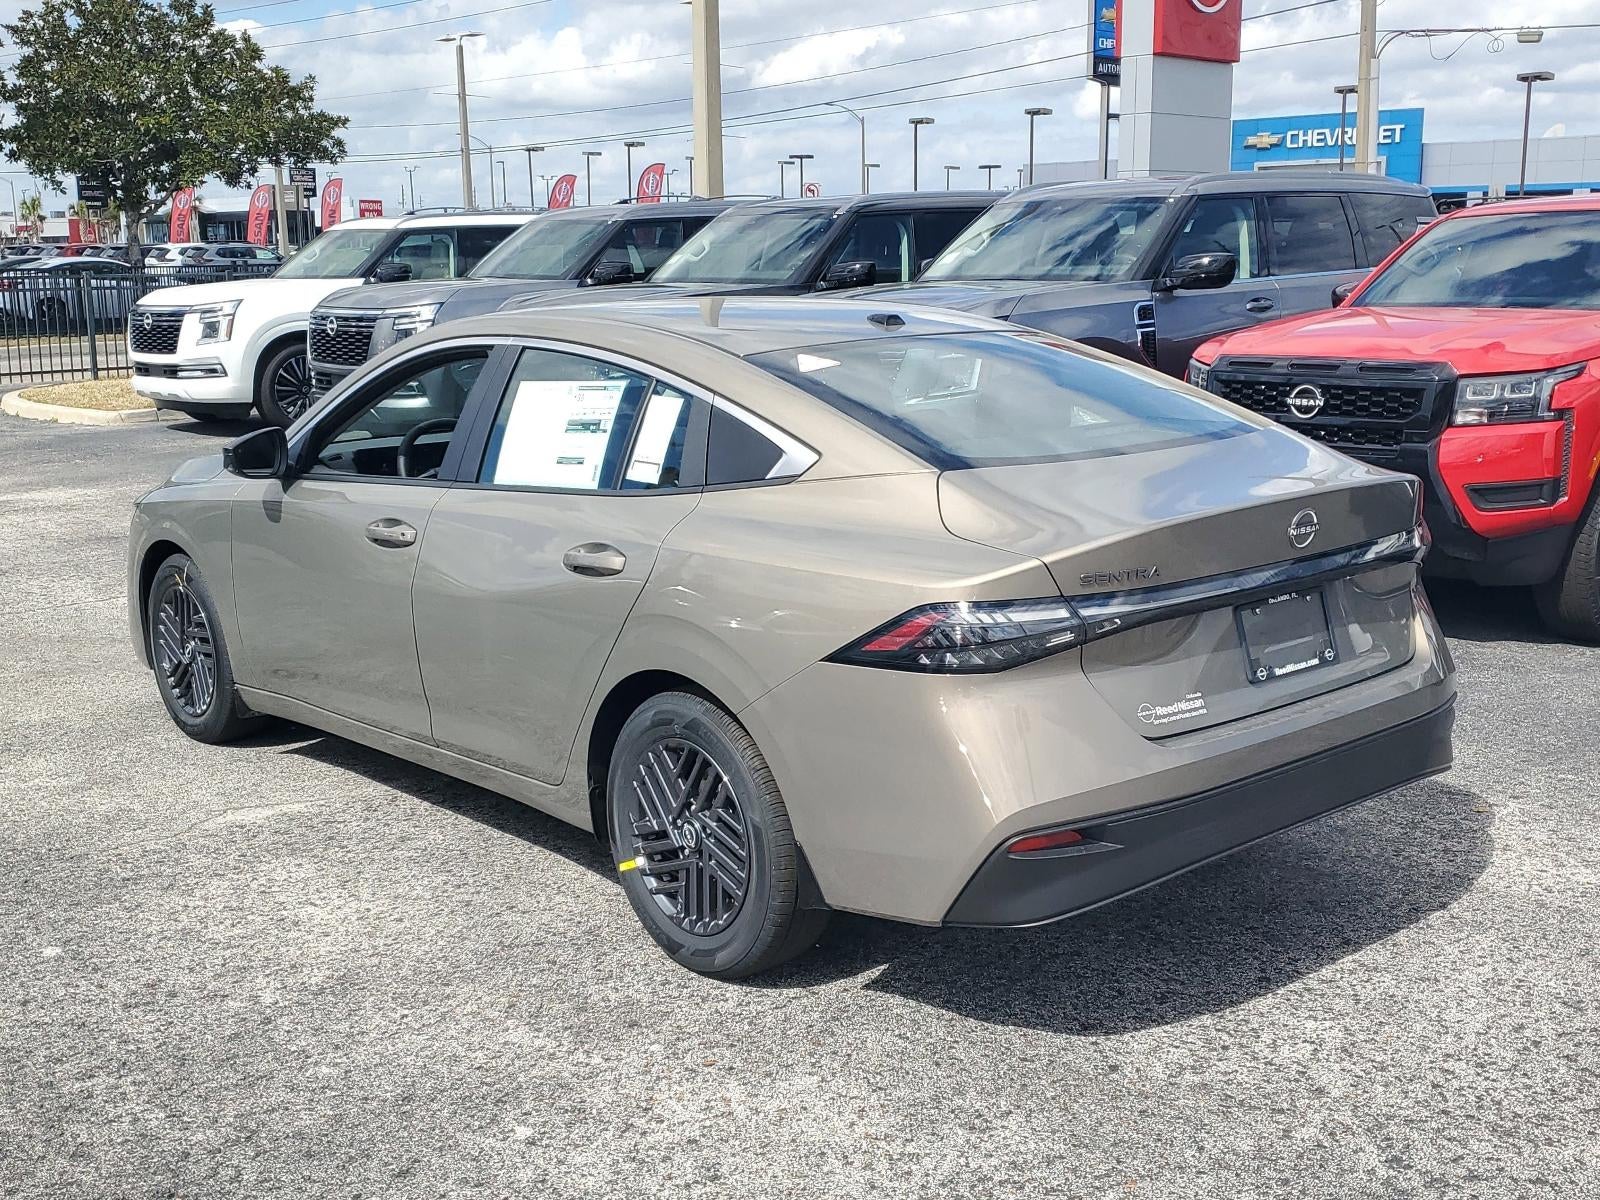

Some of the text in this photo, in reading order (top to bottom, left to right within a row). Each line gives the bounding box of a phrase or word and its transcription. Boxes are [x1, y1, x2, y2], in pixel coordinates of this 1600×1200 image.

[1286, 124, 1405, 149] CHEVRET
[360, 202, 382, 210] WRONG
[1286, 398, 1325, 407] NISSAN
[1289, 523, 1320, 537] NISSAN
[1079, 565, 1161, 587] SENTRA
[1274, 658, 1320, 677] ReedNissan.com
[1178, 699, 1205, 712] Nissan
